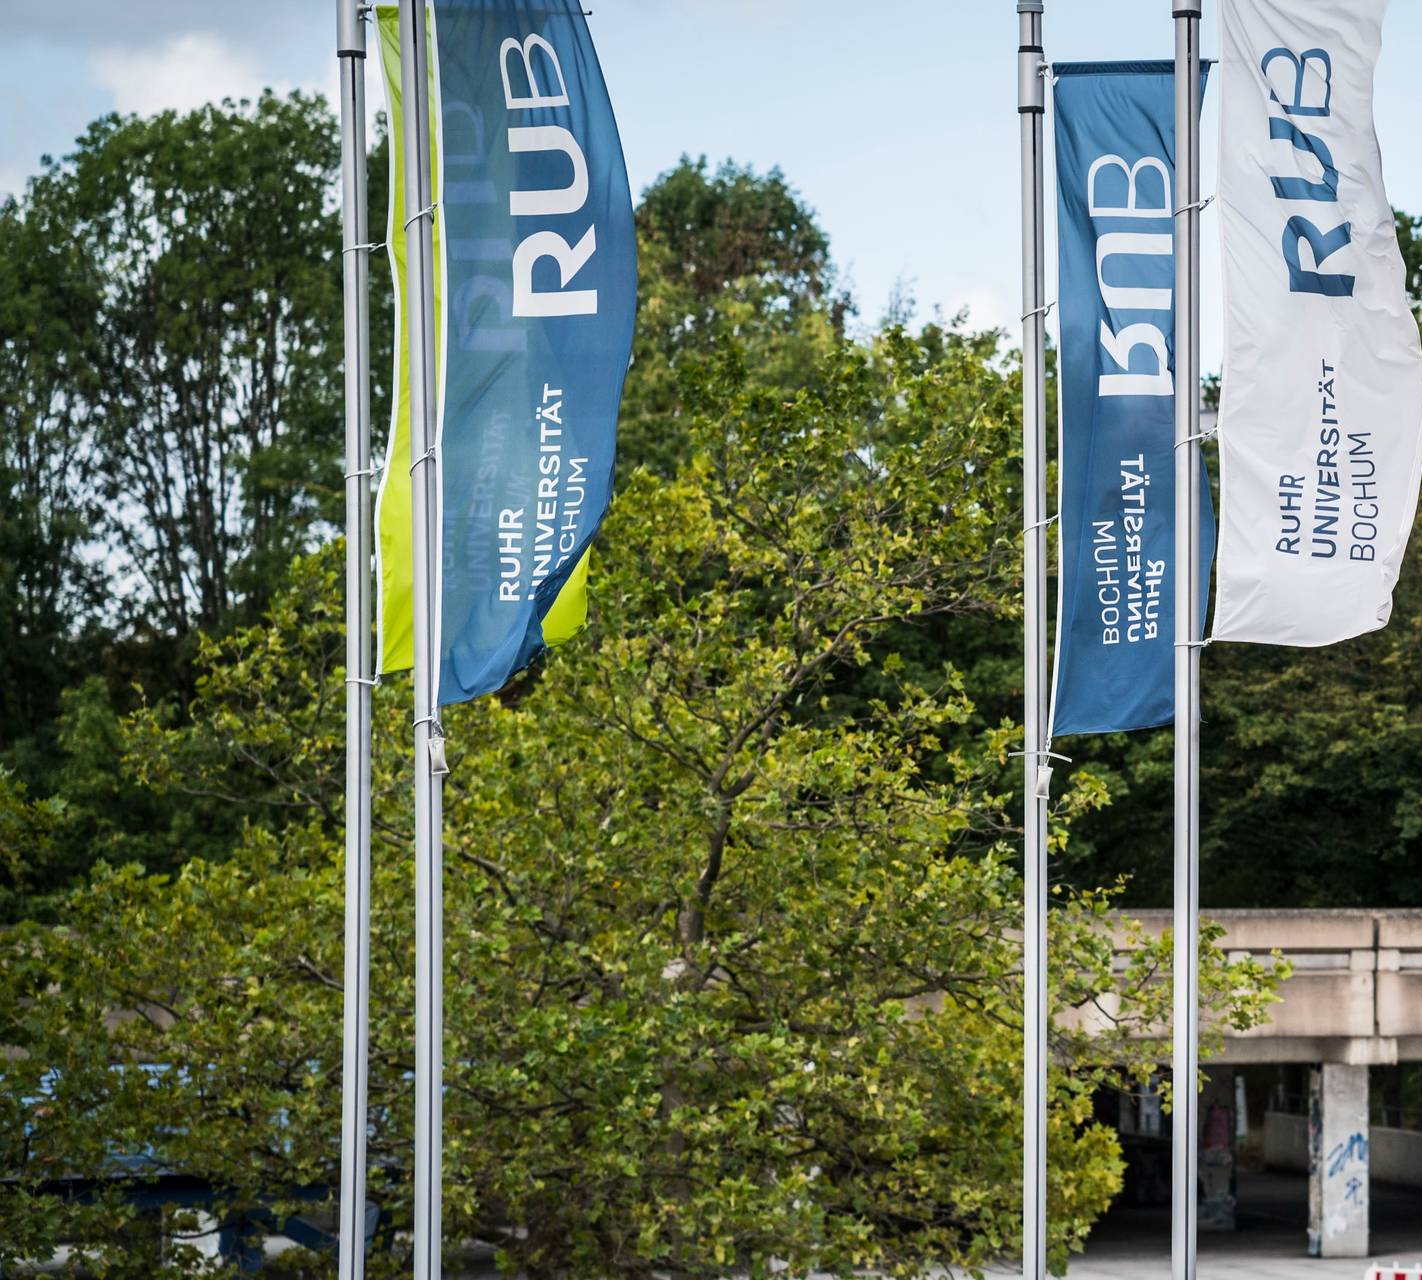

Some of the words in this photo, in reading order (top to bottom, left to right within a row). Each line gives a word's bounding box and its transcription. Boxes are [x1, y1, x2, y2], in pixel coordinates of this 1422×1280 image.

[500, 32, 598, 318] RUB
[1260, 46, 1356, 298] RUB
[1275, 473, 1306, 557] RUHR
[1311, 358, 1341, 560] UNIVERSITÄT
[1347, 431, 1378, 563] BOCHUM
[498, 506, 525, 602] RUHR
